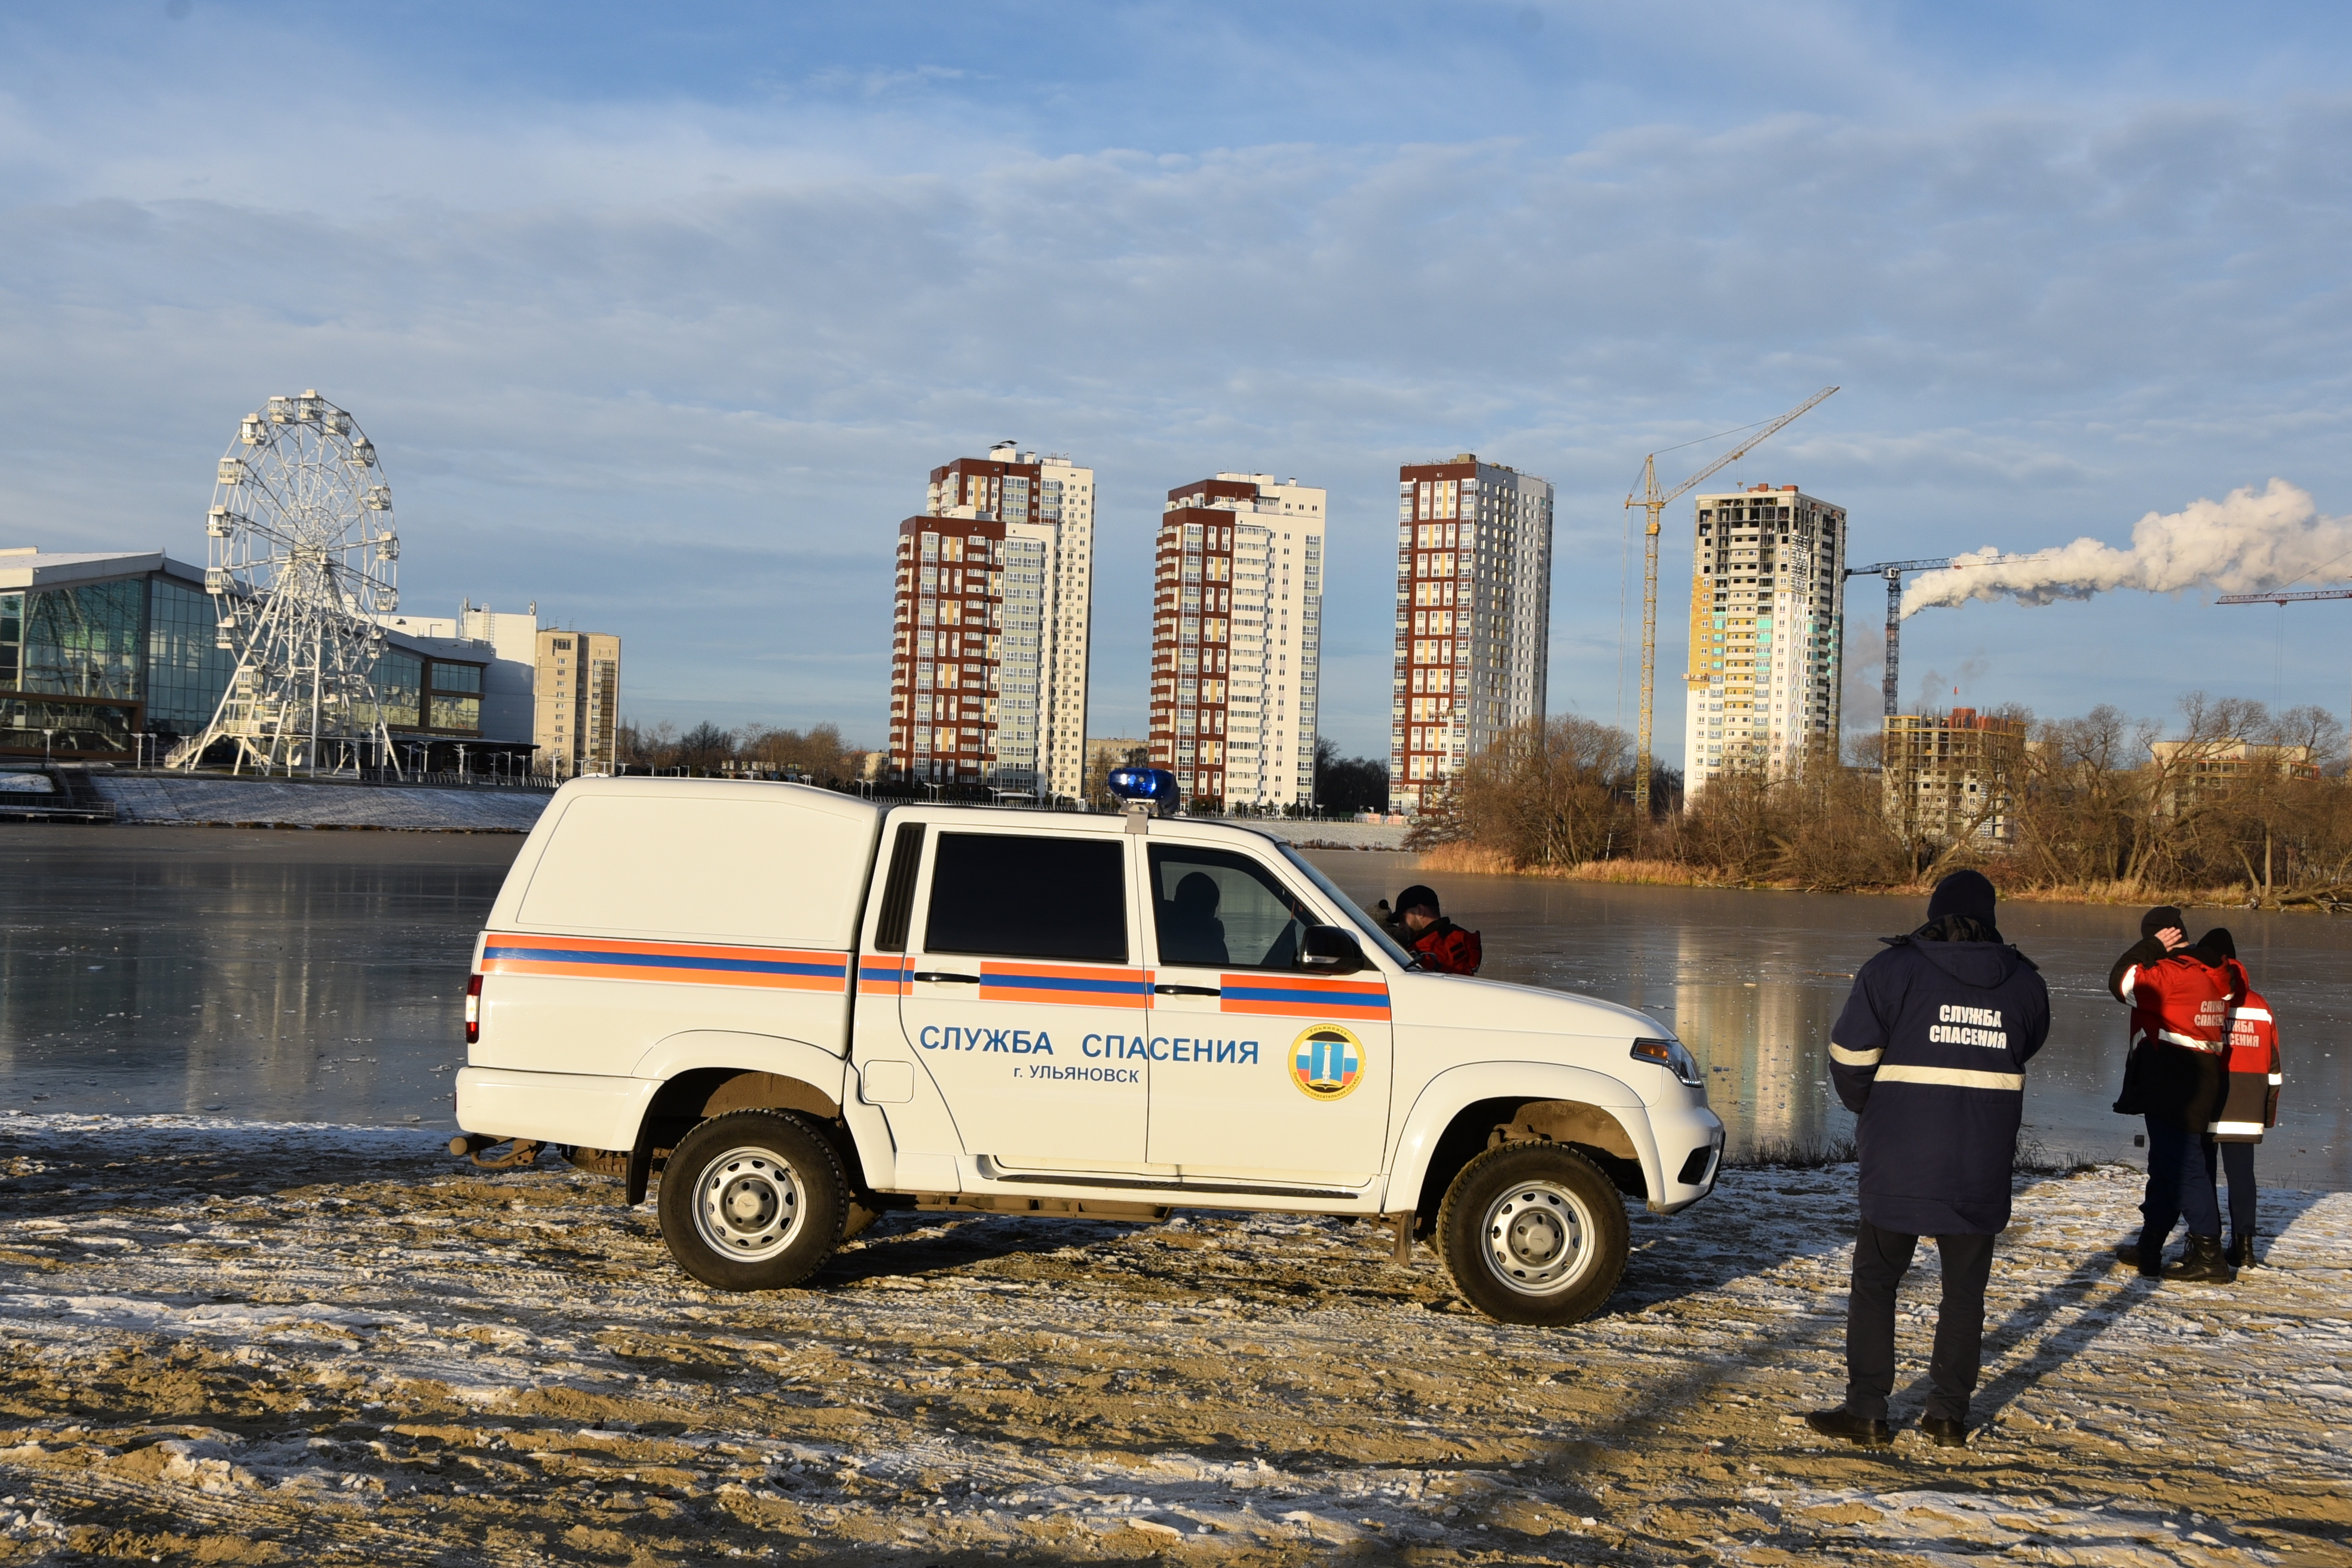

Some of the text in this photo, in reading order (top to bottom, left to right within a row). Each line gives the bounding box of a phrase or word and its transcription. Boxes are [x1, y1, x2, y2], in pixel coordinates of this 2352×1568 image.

[1939, 1004, 2002, 1027] СЛУЖБА
[920, 1025, 1258, 1065] СЛУЖБА СПАСЕНИЯ
[1930, 1025, 2007, 1049] СПАСЕНИЯ
[1013, 1065, 1140, 1083] г. УЛЬЯНОВСК
